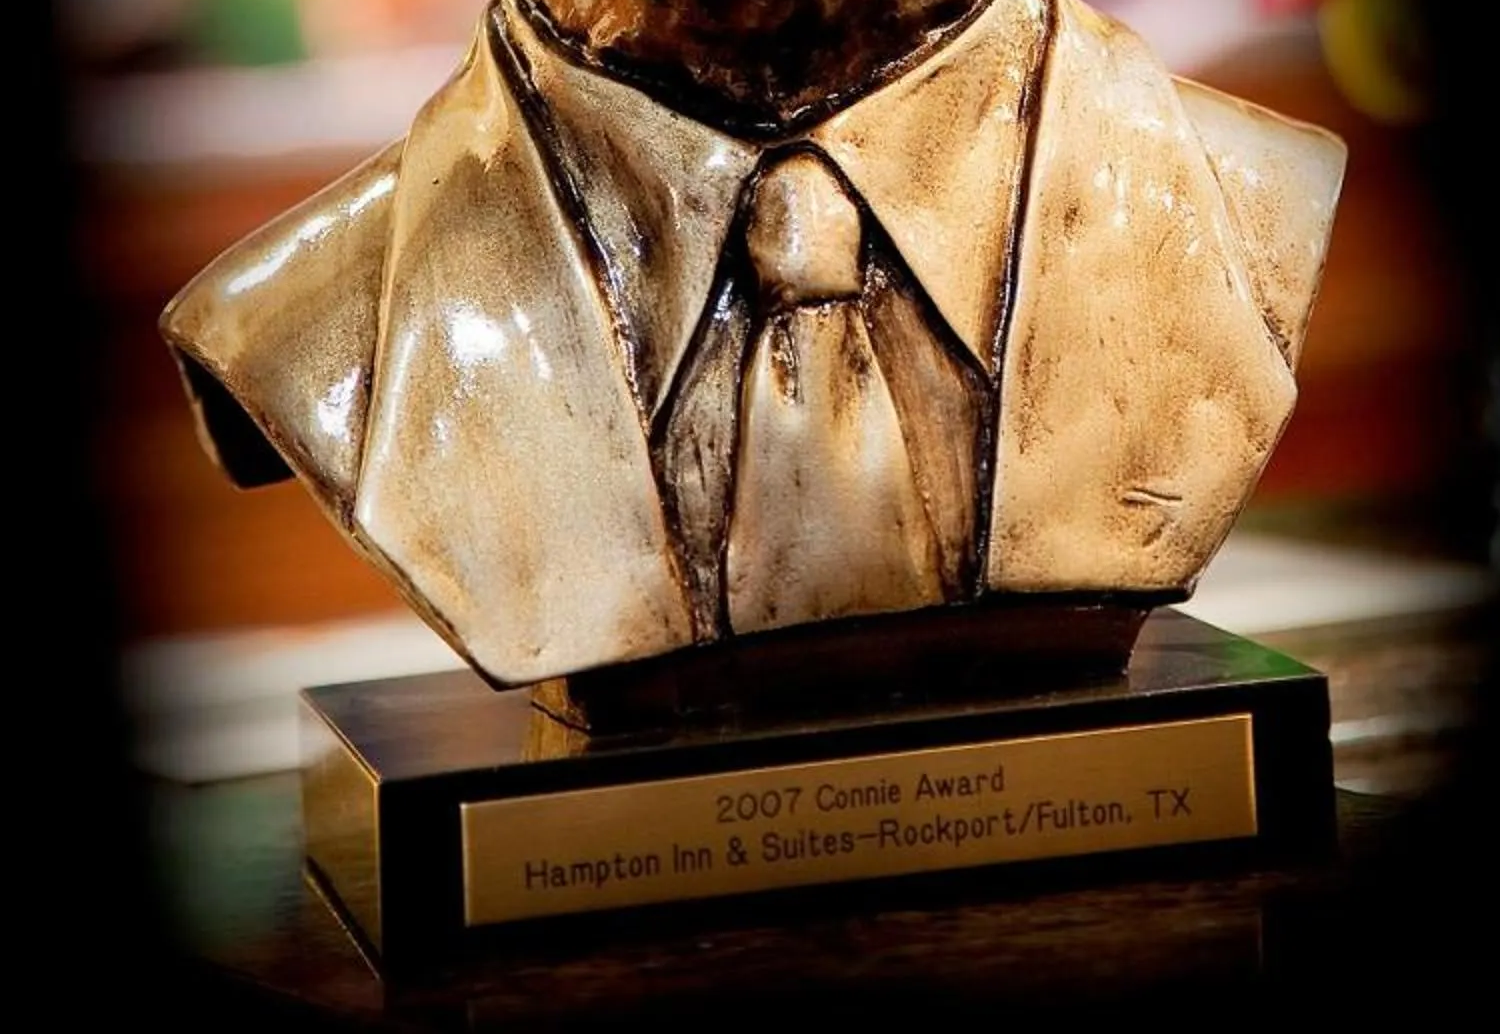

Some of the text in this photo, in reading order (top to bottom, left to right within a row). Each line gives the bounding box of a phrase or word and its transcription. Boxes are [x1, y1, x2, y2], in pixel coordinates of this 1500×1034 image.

[716, 765, 1005, 823] 2007 Connie Award
[524, 853, 661, 891] Hampton
[673, 843, 713, 874] Inn
[726, 836, 748, 866] &
[1146, 786, 1193, 819] TX
